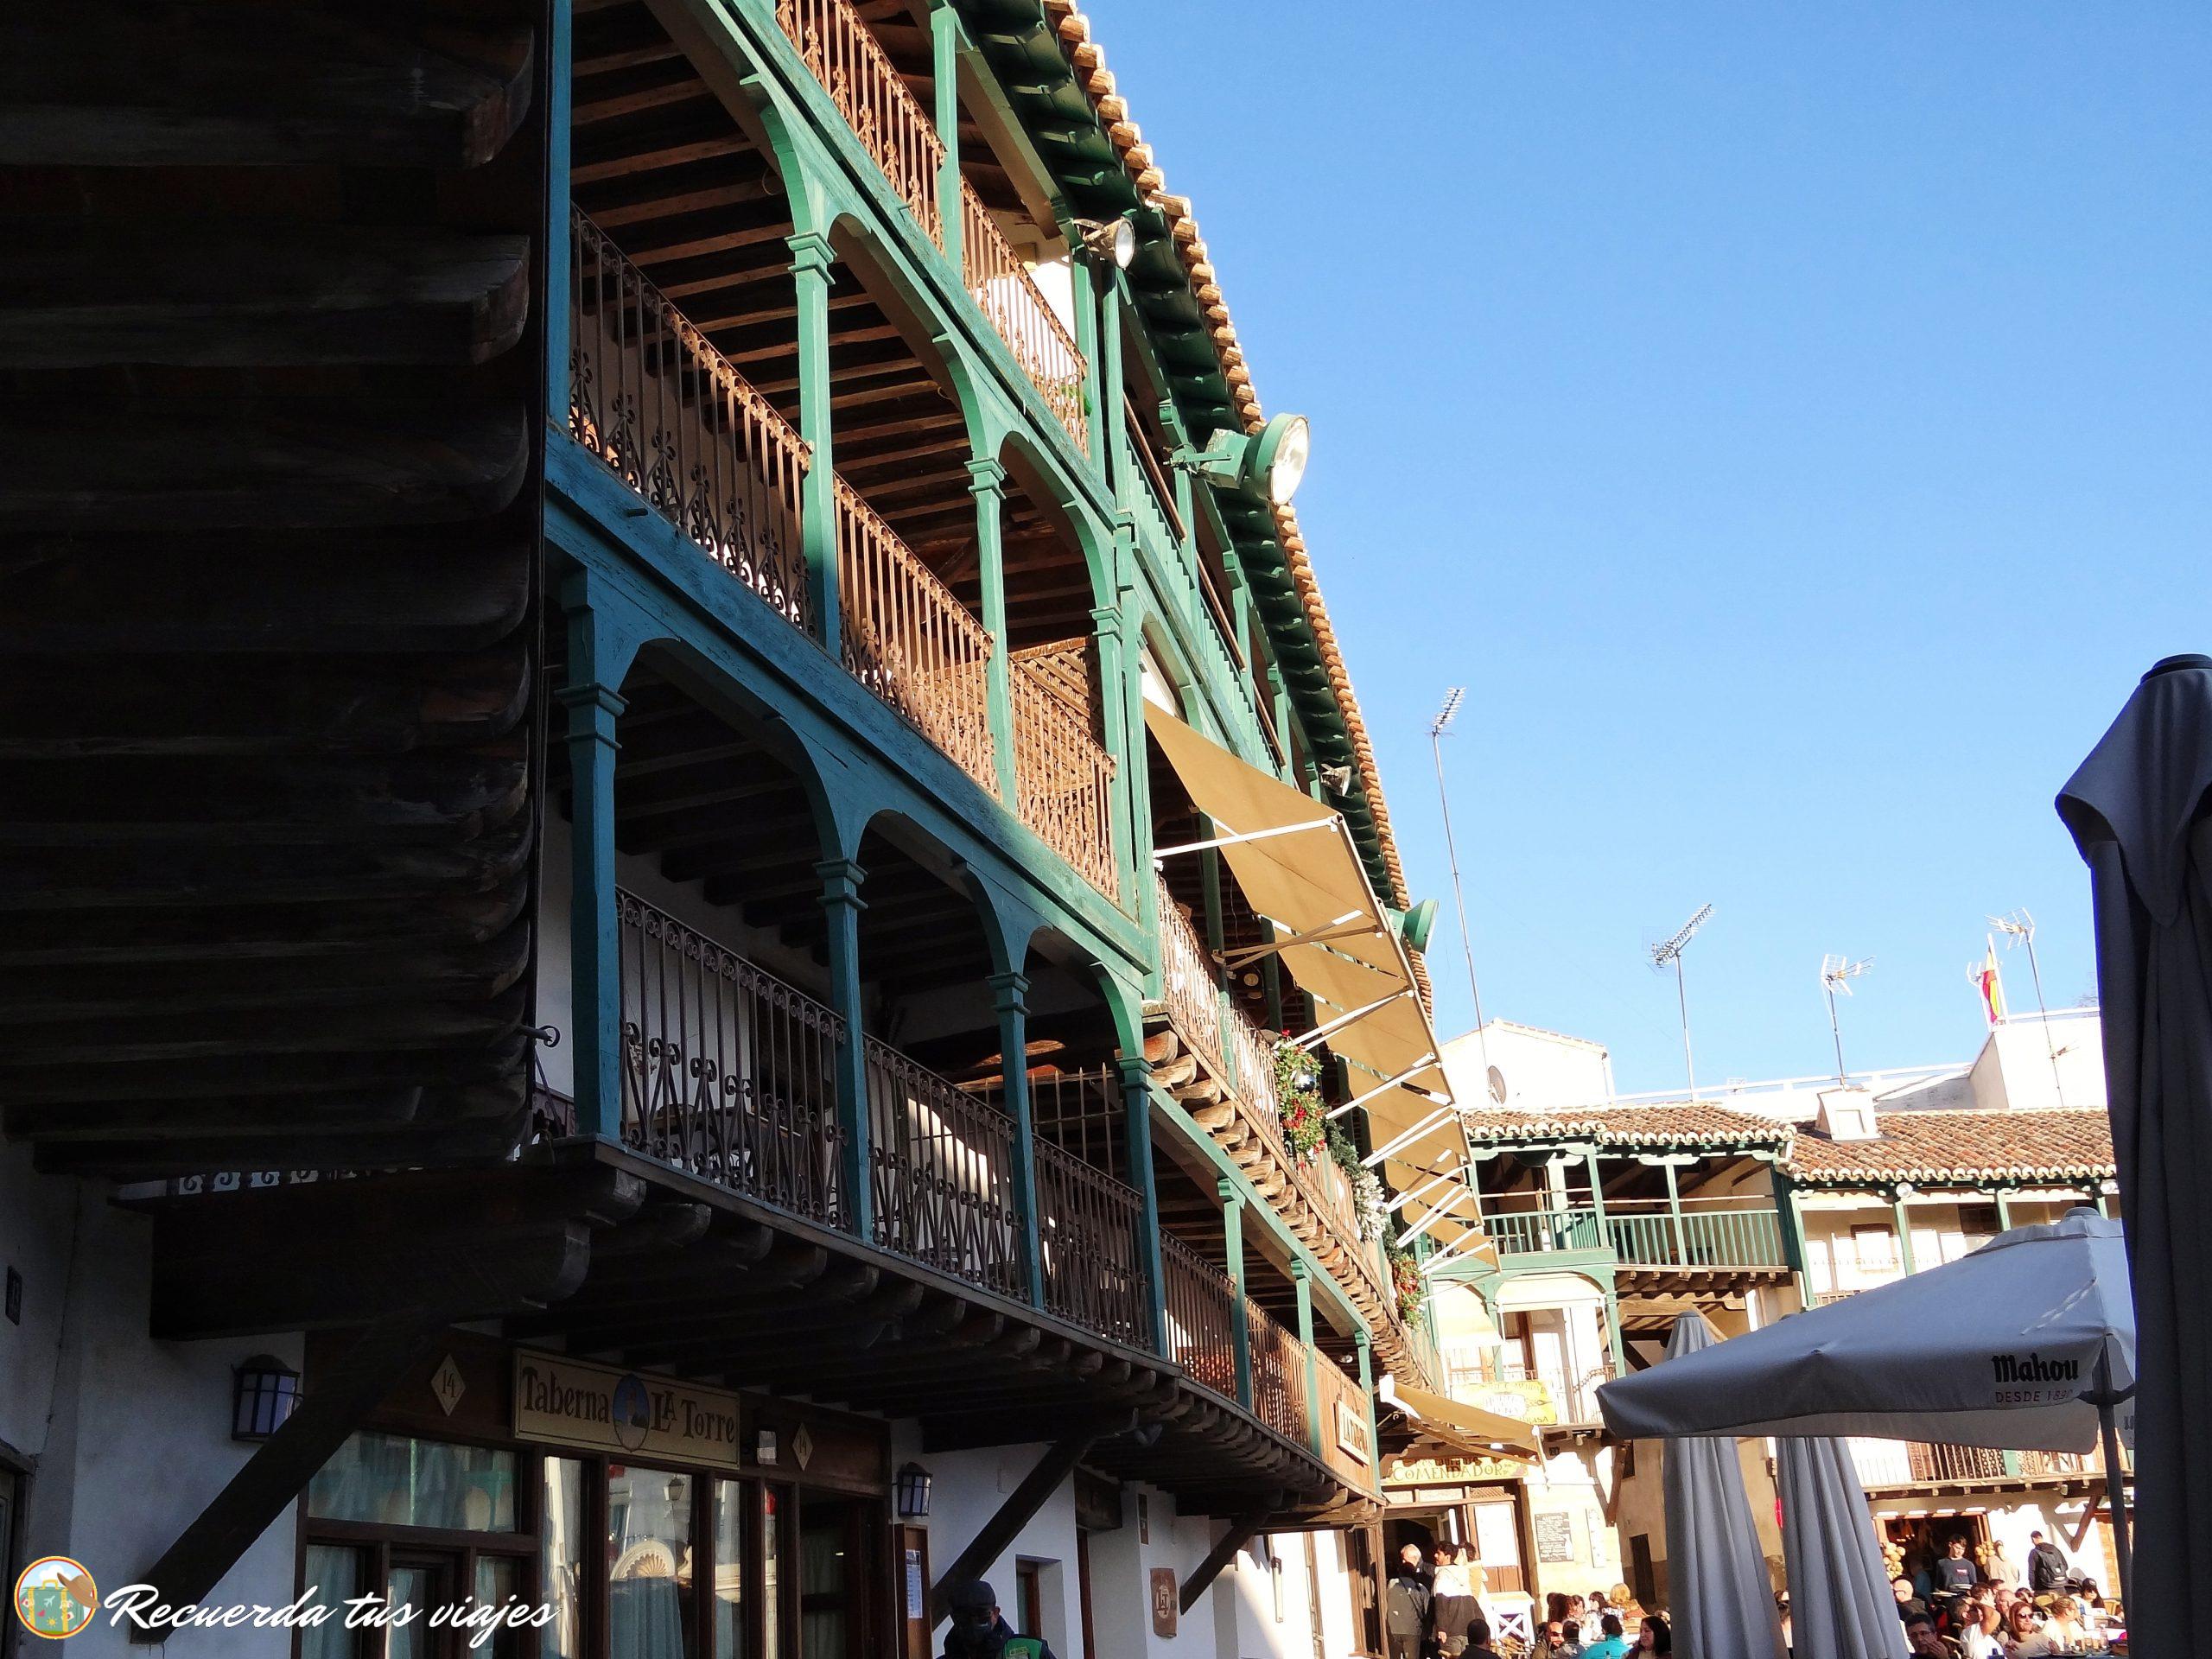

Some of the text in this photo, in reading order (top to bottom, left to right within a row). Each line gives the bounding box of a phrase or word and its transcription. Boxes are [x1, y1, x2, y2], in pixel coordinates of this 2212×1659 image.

[1991, 1352, 2079, 1382] Mahou
[442, 1369, 457, 1398] 14
[1995, 1390, 2041, 1403] DESDE
[522, 1366, 735, 1444] Taberna LA Torre
